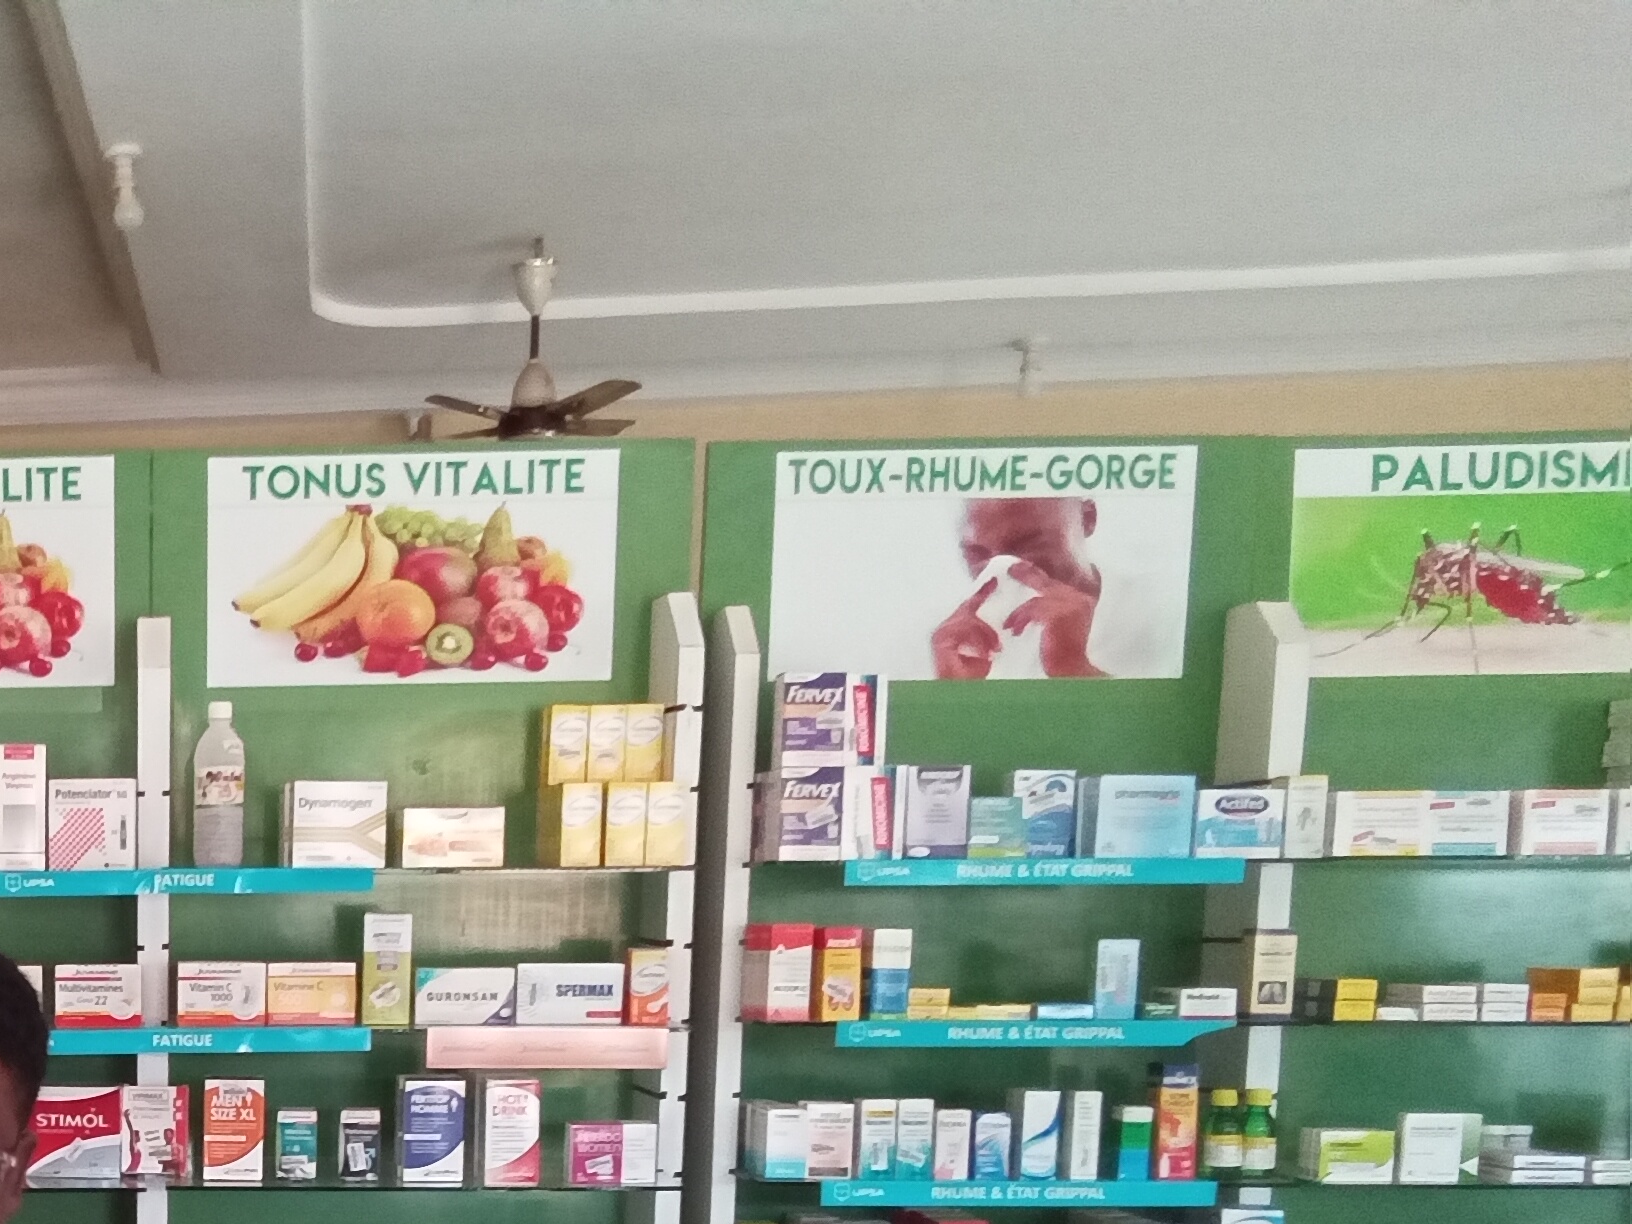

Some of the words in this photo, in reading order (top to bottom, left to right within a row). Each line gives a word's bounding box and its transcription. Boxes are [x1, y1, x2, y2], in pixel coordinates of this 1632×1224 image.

[242, 463, 388, 502] TONUS
[405, 458, 587, 496] VITALITE
[788, 453, 1179, 496] TOUX-RHUME-GORGE
[786, 685, 844, 704] FERVEX
[783, 780, 840, 799] FERVEX
[58, 983, 124, 993] Multivitamines
[555, 984, 614, 998] SPERMAX
[426, 991, 499, 1002] GURONSAN
[152, 1034, 213, 1047] FATIGUE
[210, 1107, 237, 1121] SIZE
[239, 1108, 257, 1121] XL
